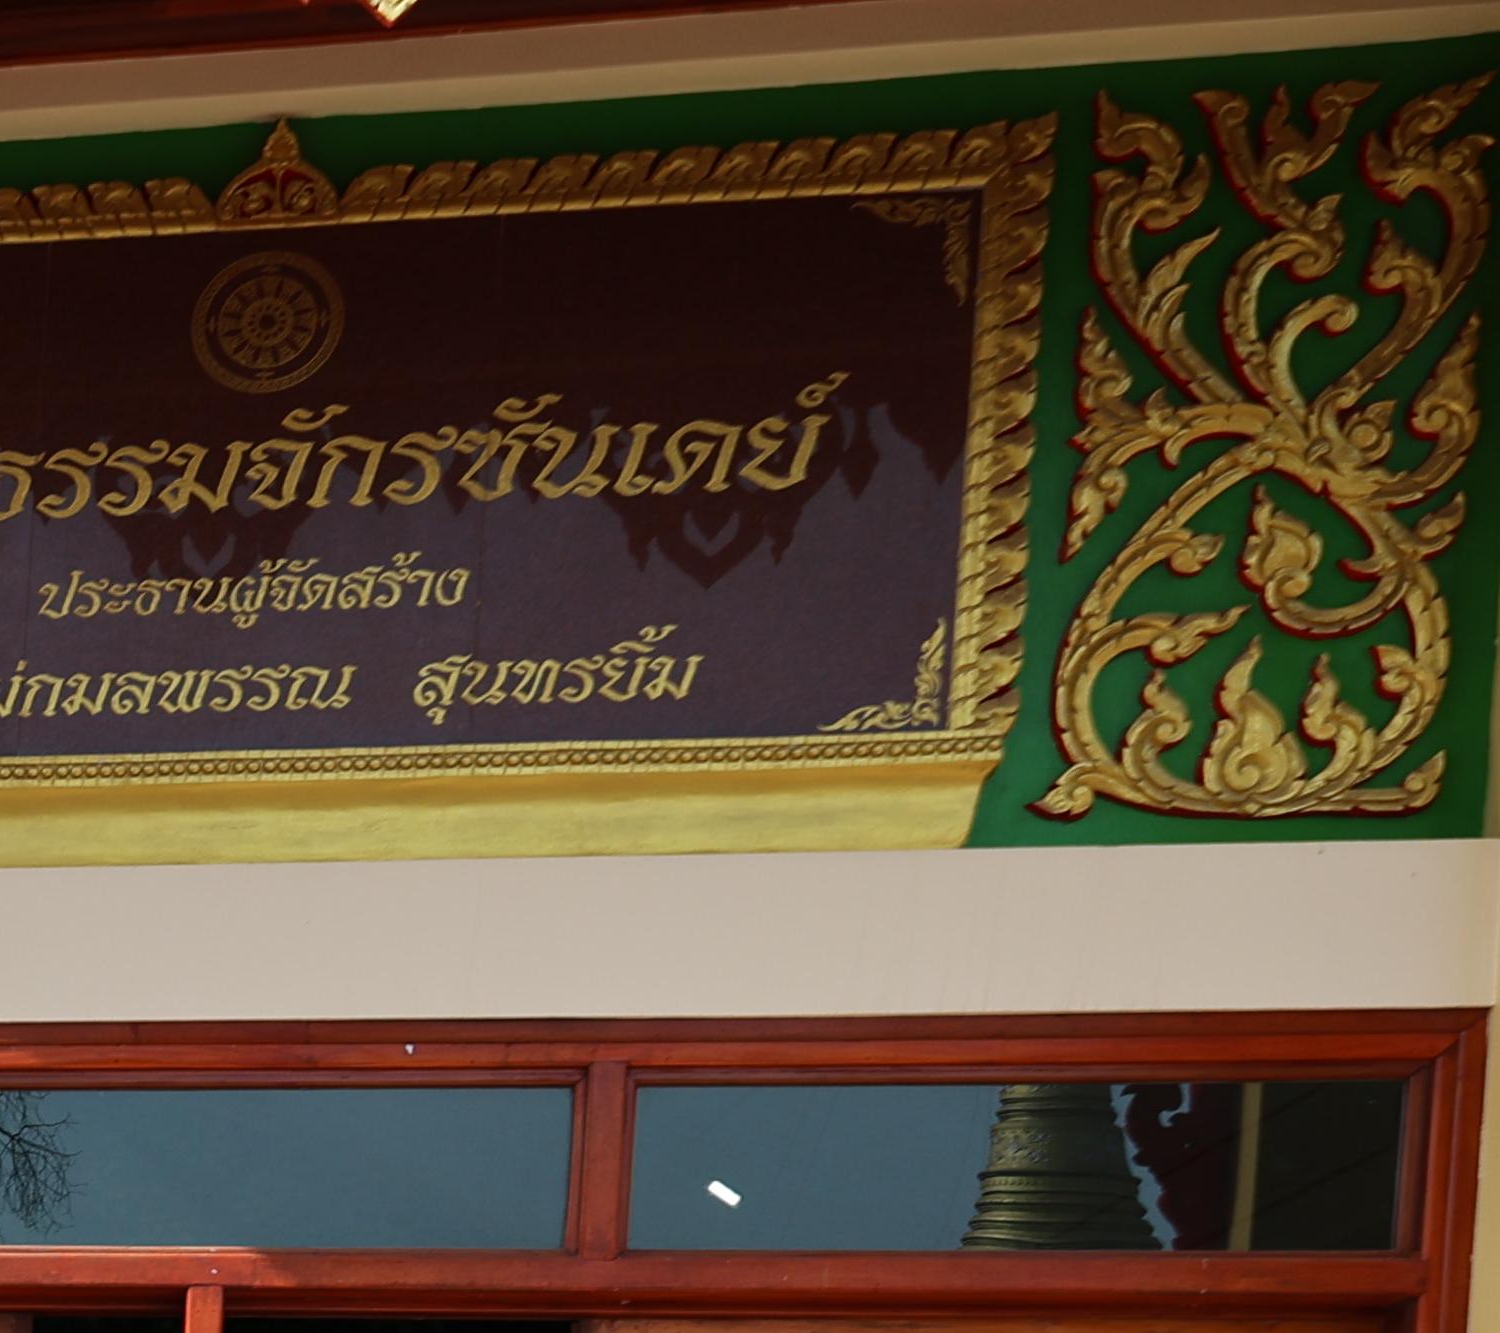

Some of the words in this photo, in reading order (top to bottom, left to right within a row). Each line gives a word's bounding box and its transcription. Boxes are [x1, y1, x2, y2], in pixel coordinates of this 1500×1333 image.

[38, 551, 470, 630] ประธานผู้จัดสร้าง
